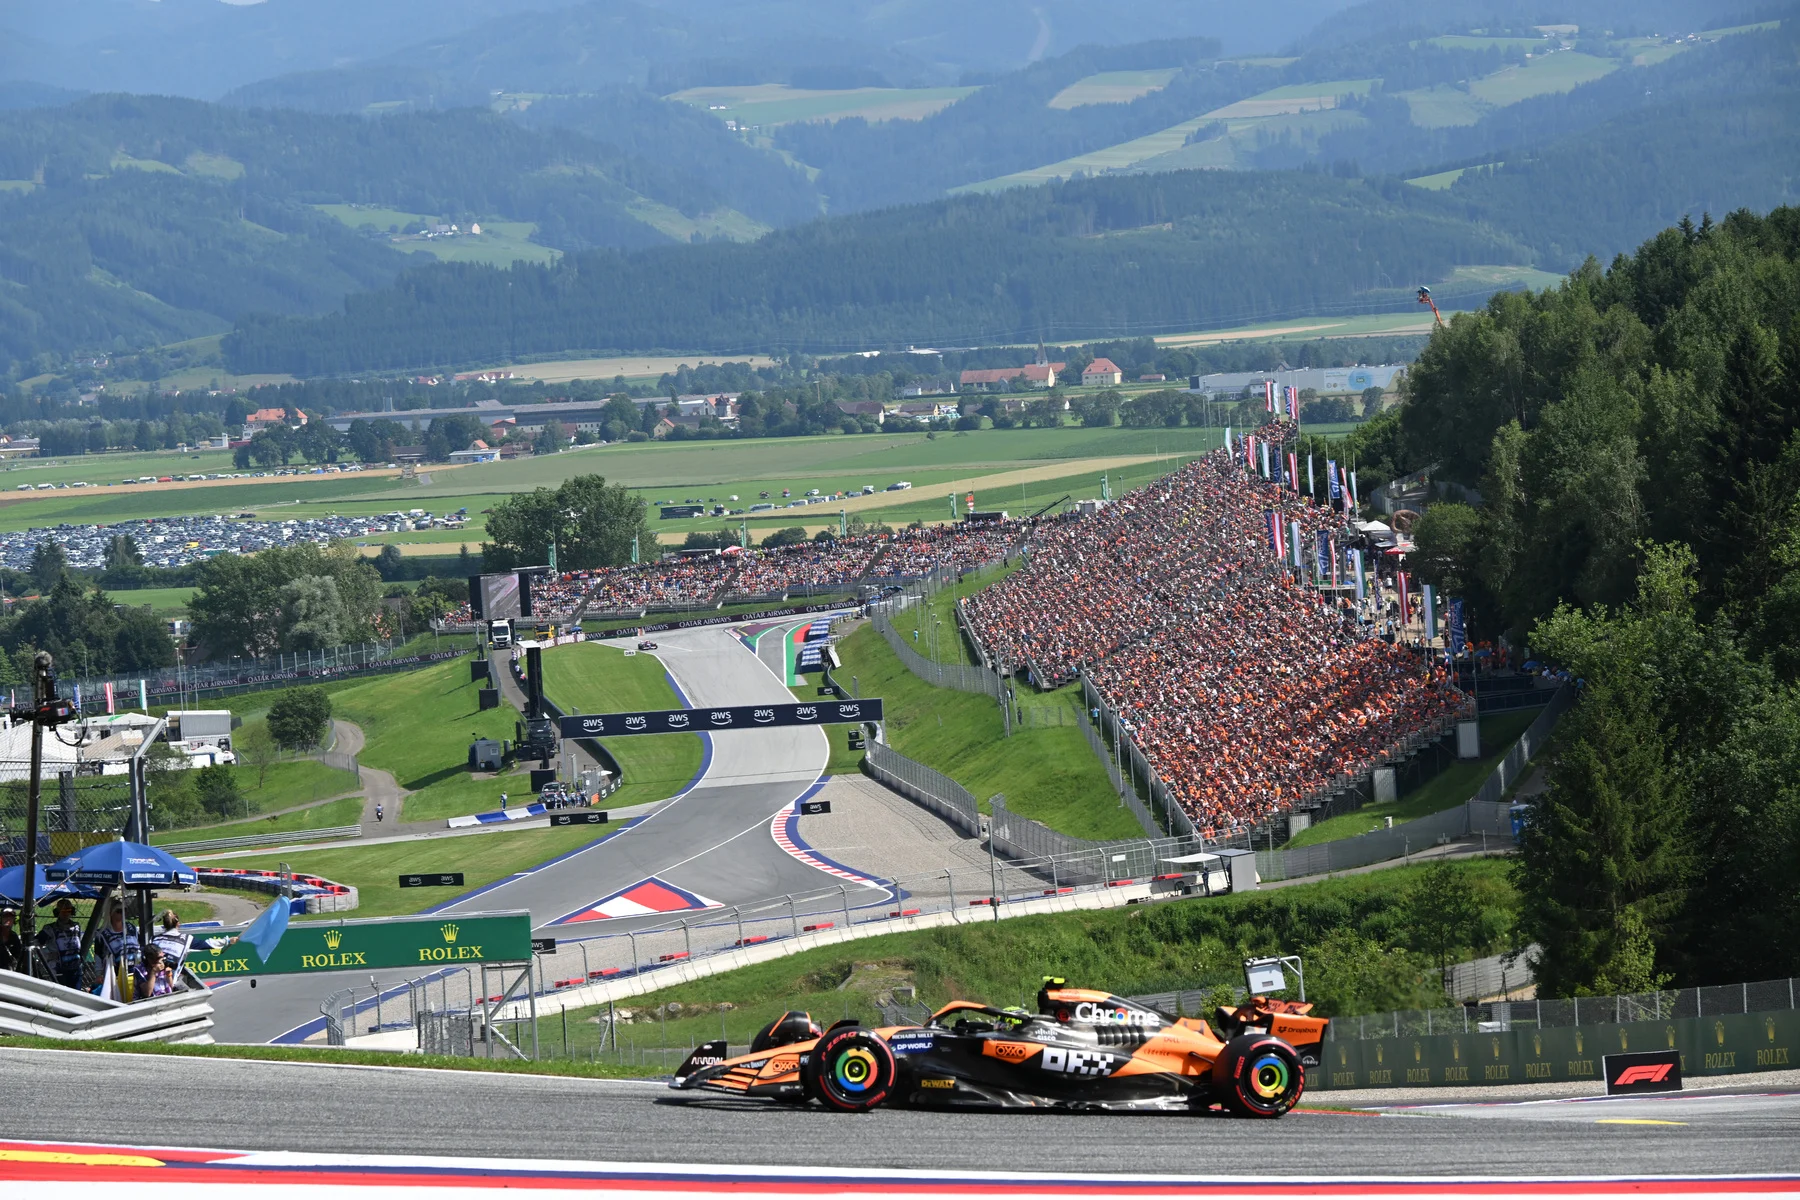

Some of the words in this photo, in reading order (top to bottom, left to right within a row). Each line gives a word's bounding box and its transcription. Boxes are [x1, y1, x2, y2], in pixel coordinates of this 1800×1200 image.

[830, 600, 859, 609] AIRWAYS
[742, 612, 765, 621] QATAR
[766, 608, 795, 618] AIRWAYS
[679, 620, 701, 629] QATAR
[702, 616, 731, 625] AIRWAYS
[430, 651, 453, 660] QATAR
[369, 660, 392, 669] QATAR
[392, 656, 420, 665] AIRWAYS
[331, 664, 359, 674] AIRWAYS
[210, 678, 237, 688] AIRWAYS
[247, 675, 270, 684] QATAR
[270, 672, 298, 681] AIRWAYS
[150, 685, 177, 694] AIRWAYS
[583, 718, 603, 727] aws
[625, 716, 646, 725] aws
[668, 713, 689, 722] aws
[711, 711, 731, 720] aws
[754, 709, 774, 718] aws
[796, 706, 817, 715] aws
[839, 704, 859, 713] aws
[185, 958, 250, 974] ROLEX
[301, 952, 367, 968] ROLEX
[418, 945, 484, 961] ROLEX
[1075, 1002, 1160, 1026] Chrome
[1287, 1027, 1318, 1035] Dropbox
[826, 1031, 857, 1051] ZERO
[897, 1043, 907, 1051] DP
[907, 1042, 933, 1050] WORLD
[996, 1045, 1026, 1057] OXXO
[691, 1056, 723, 1065] ARROW
[773, 1061, 799, 1071] OXXO
[1041, 1047, 1114, 1076] OKX
[1333, 1072, 1355, 1086] ROLEX
[1369, 1069, 1392, 1085] ROLEX
[1406, 1068, 1430, 1083] ROLEX
[1445, 1066, 1469, 1081] ROLEX
[1485, 1064, 1509, 1080] ROLEX
[1525, 1062, 1552, 1078] ROLEX
[1568, 1060, 1594, 1076] ROLEX
[1705, 1051, 1736, 1069] ROLEX
[1757, 1047, 1789, 1066] ROLEX
[1613, 1063, 1674, 1086] F1
